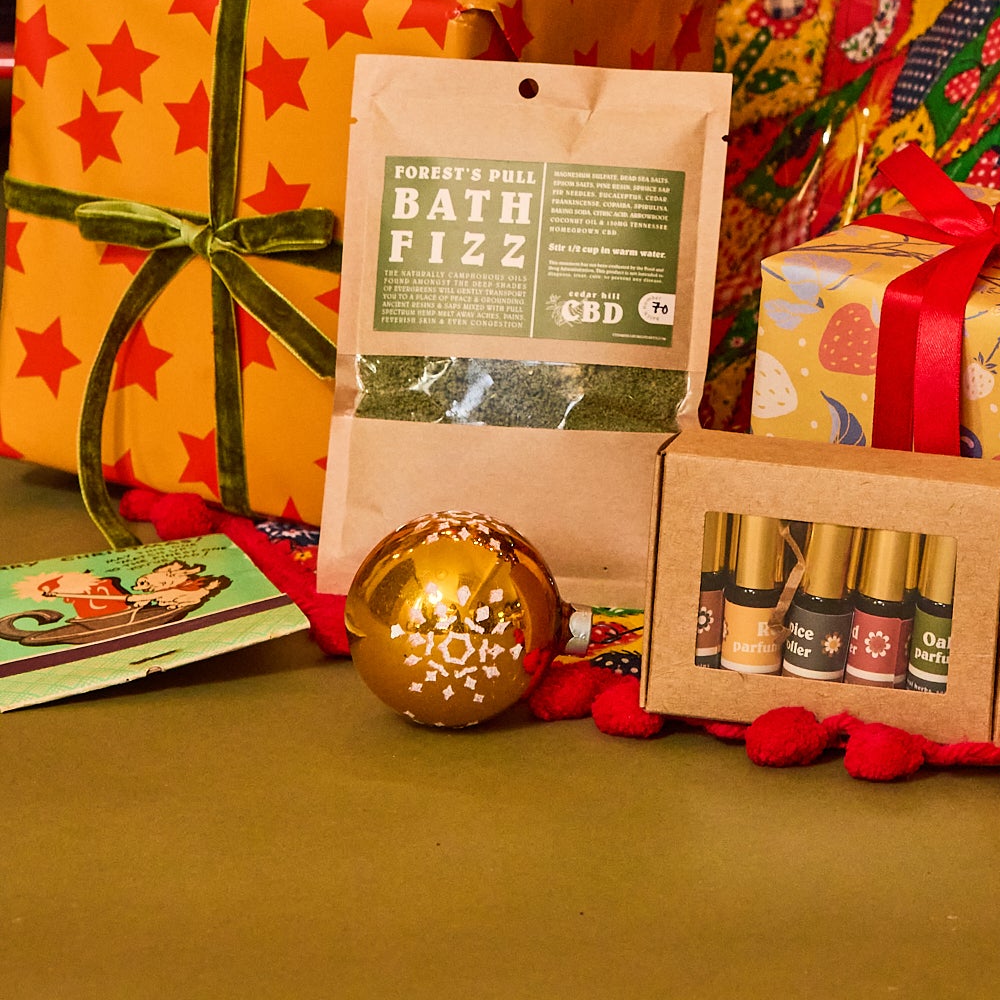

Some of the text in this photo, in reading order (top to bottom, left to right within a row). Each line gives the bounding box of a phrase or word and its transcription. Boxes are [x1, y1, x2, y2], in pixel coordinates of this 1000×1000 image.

[395, 166, 536, 184] FOREST'S PULL
[392, 187, 533, 224] BATH
[549, 226, 598, 234] HOMEGROWN
[389, 230, 526, 269] FIZZ
[548, 242, 565, 251] Stir
[582, 246, 599, 255] cup
[600, 246, 610, 254] in
[612, 248, 637, 256] warm
[639, 250, 666, 258] water.
[402, 270, 444, 278] NATURALLY
[485, 289, 526, 297] TRANSPORT
[568, 290, 597, 298] cedar
[480, 297, 524, 305] GROUNDING
[381, 308, 415, 316] SPECTRUM
[560, 299, 624, 324] CBD
[447, 318, 467, 326] EVEN
